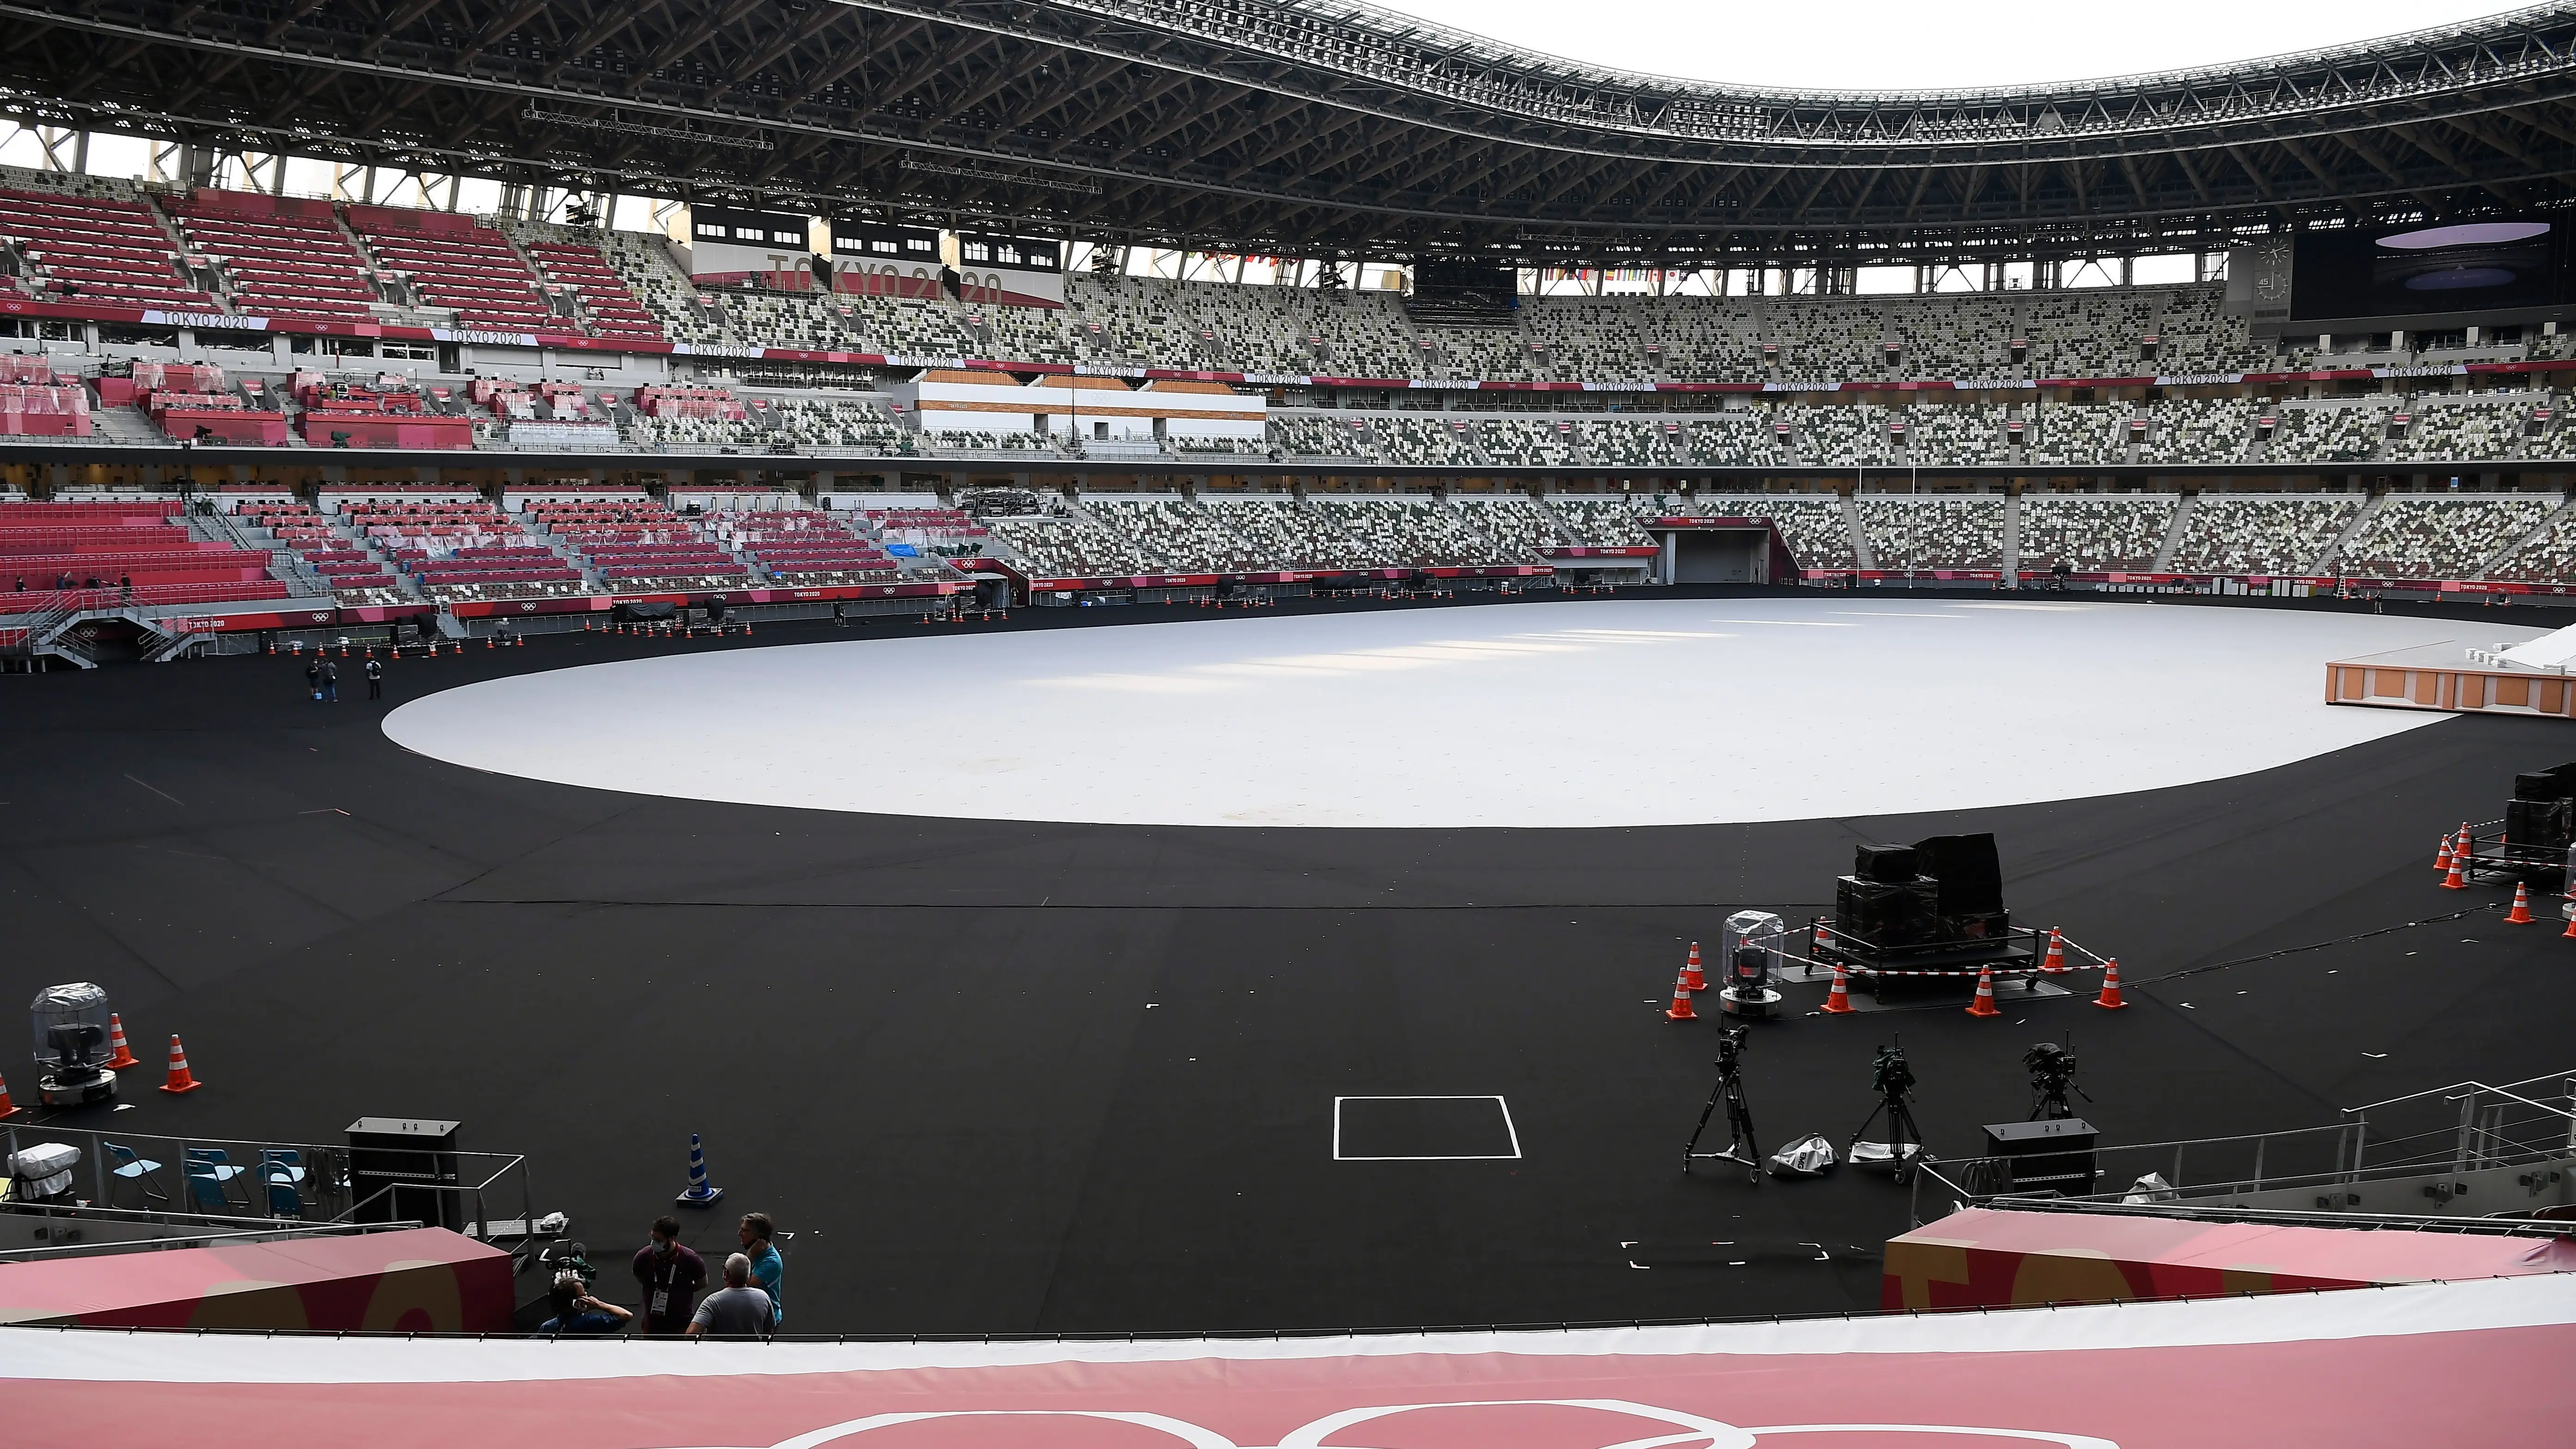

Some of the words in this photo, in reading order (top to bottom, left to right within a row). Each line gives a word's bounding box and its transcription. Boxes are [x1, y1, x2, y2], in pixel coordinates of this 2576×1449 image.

[767, 254, 900, 297] TOKYO
[162, 312, 210, 327] TOKYO
[214, 315, 248, 329] 2020
[449, 329, 489, 343] TOKYO
[492, 332, 521, 345] 2020
[688, 344, 722, 356] TOKYO
[726, 346, 750, 358] 2020
[898, 355, 928, 367] TOKYO
[931, 358, 953, 368] 2020
[1085, 366, 1112, 376] TOKYO
[1115, 367, 1134, 377] 2020
[2387, 367, 2422, 378] TOKYO
[2425, 365, 2452, 376] 2020
[1254, 374, 1280, 384] TOKYO
[1282, 375, 1301, 384] 2020
[1420, 380, 1447, 389] TOKYO
[1449, 380, 1469, 389] 2020
[1967, 380, 1997, 389] TOKYO
[2000, 380, 2023, 389] 2020
[2169, 375, 2201, 385] TOKYO
[2205, 374, 2229, 384] 2020
[1624, 383, 1644, 391] 2020
[1776, 383, 1804, 391] TOKYO
[1807, 383, 1828, 391] 2020
[1797, 1152, 1807, 1170] EMG
